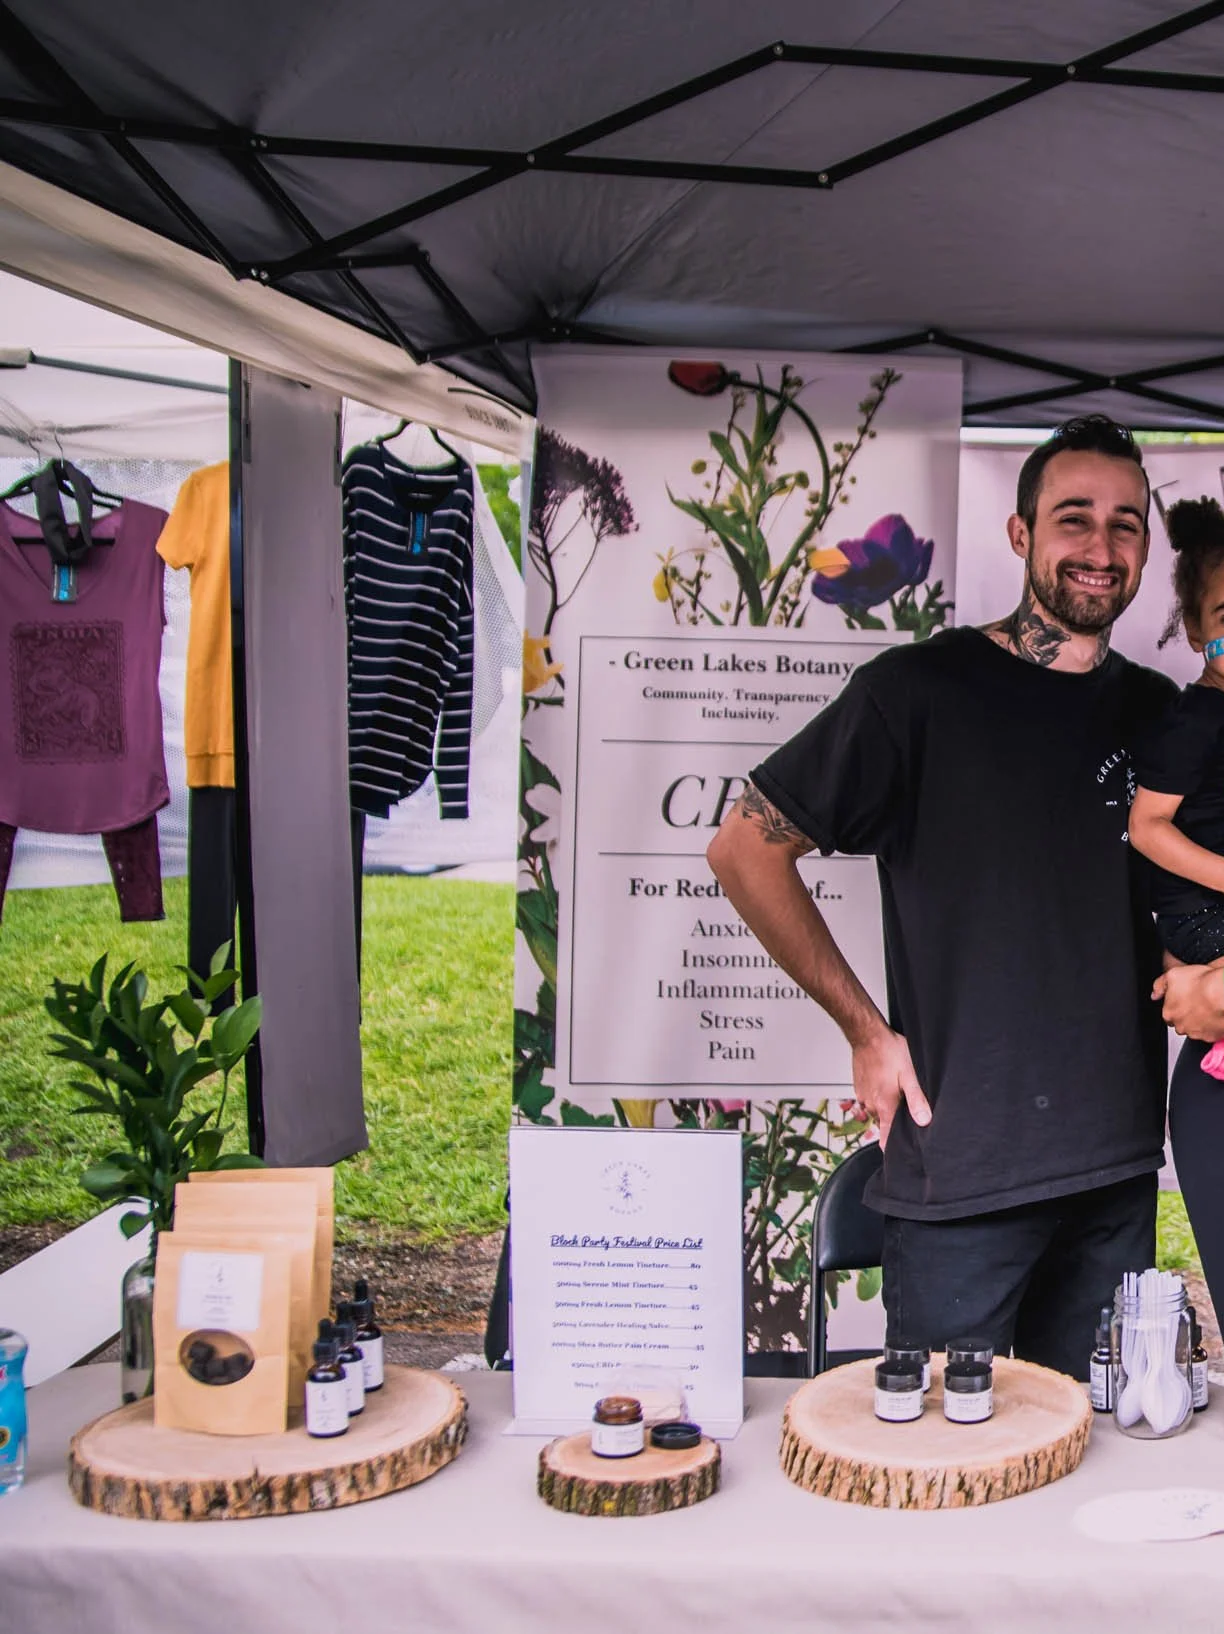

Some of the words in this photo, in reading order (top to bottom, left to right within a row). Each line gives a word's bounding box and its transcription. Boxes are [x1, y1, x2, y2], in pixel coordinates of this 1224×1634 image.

[623, 651, 694, 670] Green
[703, 653, 767, 673] Lakes
[776, 654, 856, 681] Botany
[642, 686, 728, 703] Community.
[701, 707, 780, 723] Inclusivity.
[629, 878, 668, 897] For
[681, 949, 779, 968] Insomni
[699, 1010, 764, 1029] Stress
[708, 1041, 756, 1060] Pain
[551, 1234, 579, 1248] Block
[581, 1236, 610, 1250] Party
[612, 1236, 653, 1249] Festival
[654, 1237, 680, 1249] Price
[682, 1238, 704, 1249] List
